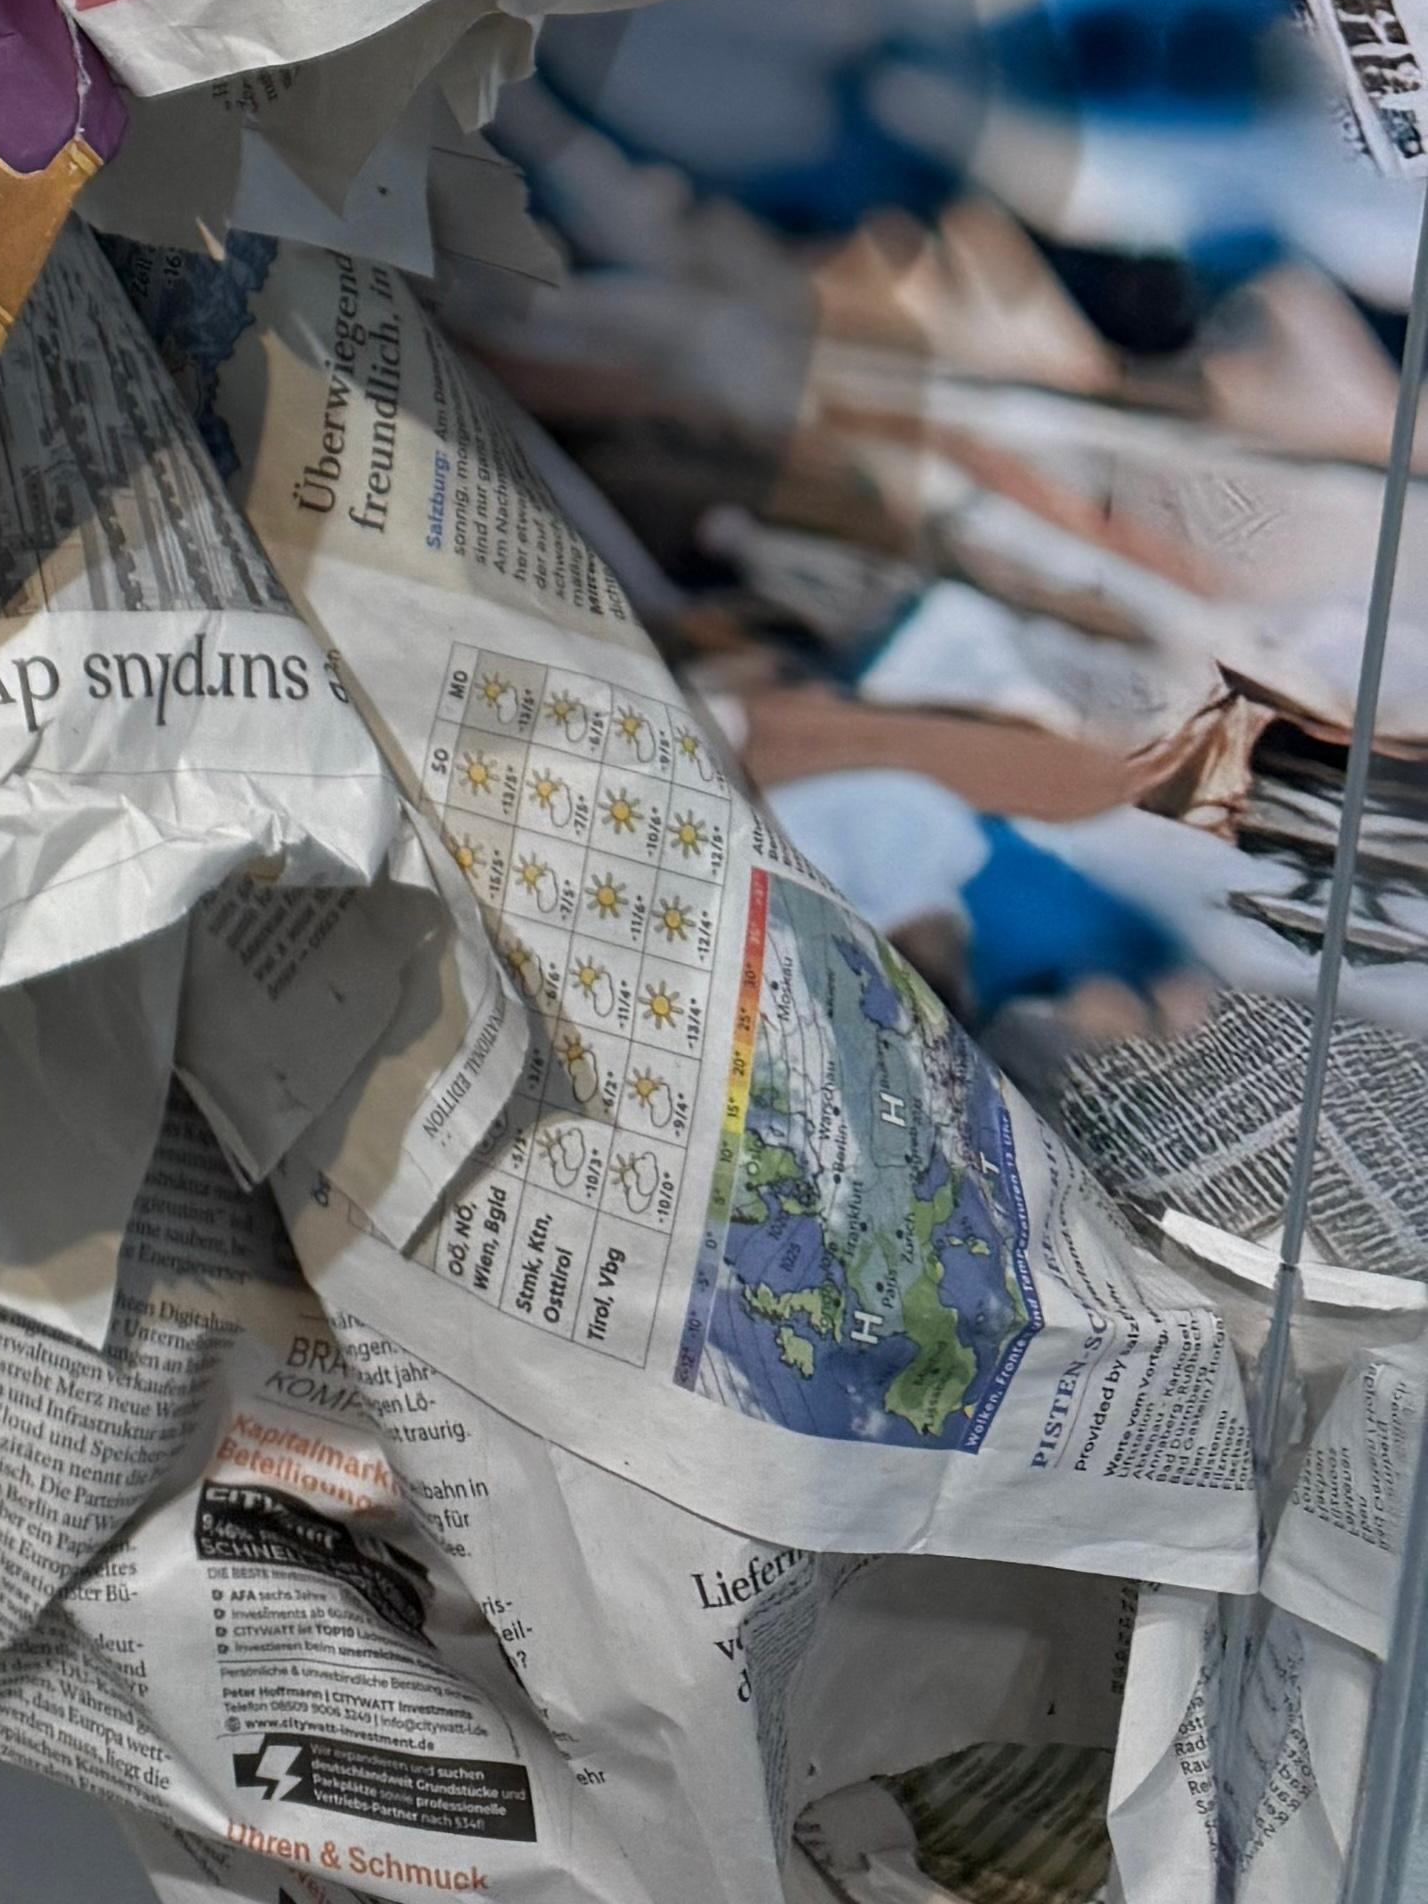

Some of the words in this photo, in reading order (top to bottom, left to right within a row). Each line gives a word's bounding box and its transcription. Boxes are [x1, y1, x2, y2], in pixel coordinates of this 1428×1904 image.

[84, 646, 311, 736] surplus
[429, 747, 451, 776] SO
[447, 669, 470, 701] MO
[526, 1212, 554, 1254] Ktn,
[514, 1257, 544, 1314] Stmk,
[542, 1246, 574, 1325] Osttirol
[596, 1246, 627, 1289] Vbg
[586, 1295, 616, 1342] Tirol,
[318, 1841, 343, 1871] &
[348, 1845, 490, 1896] Schmuck
